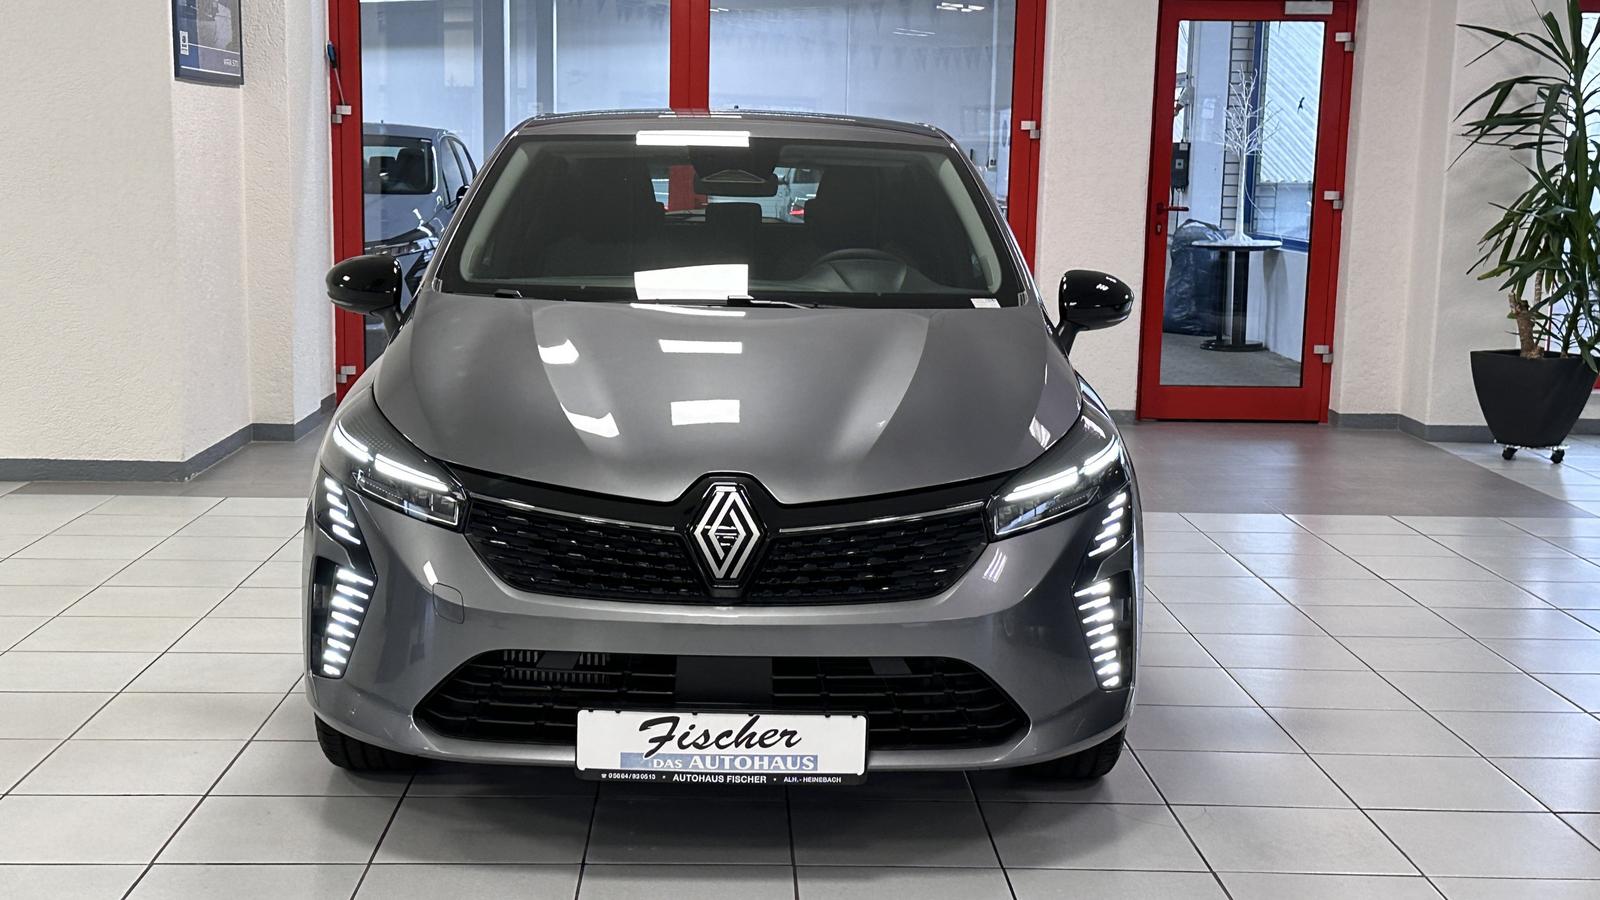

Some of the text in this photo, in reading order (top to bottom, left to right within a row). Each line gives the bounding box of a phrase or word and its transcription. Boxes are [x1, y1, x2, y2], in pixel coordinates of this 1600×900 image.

[638, 715, 802, 758] Fischer
[653, 755, 815, 771] DAS AUTOHAUS
[673, 774, 725, 783] AUTOHAUS
[727, 775, 767, 784] FISCHER
